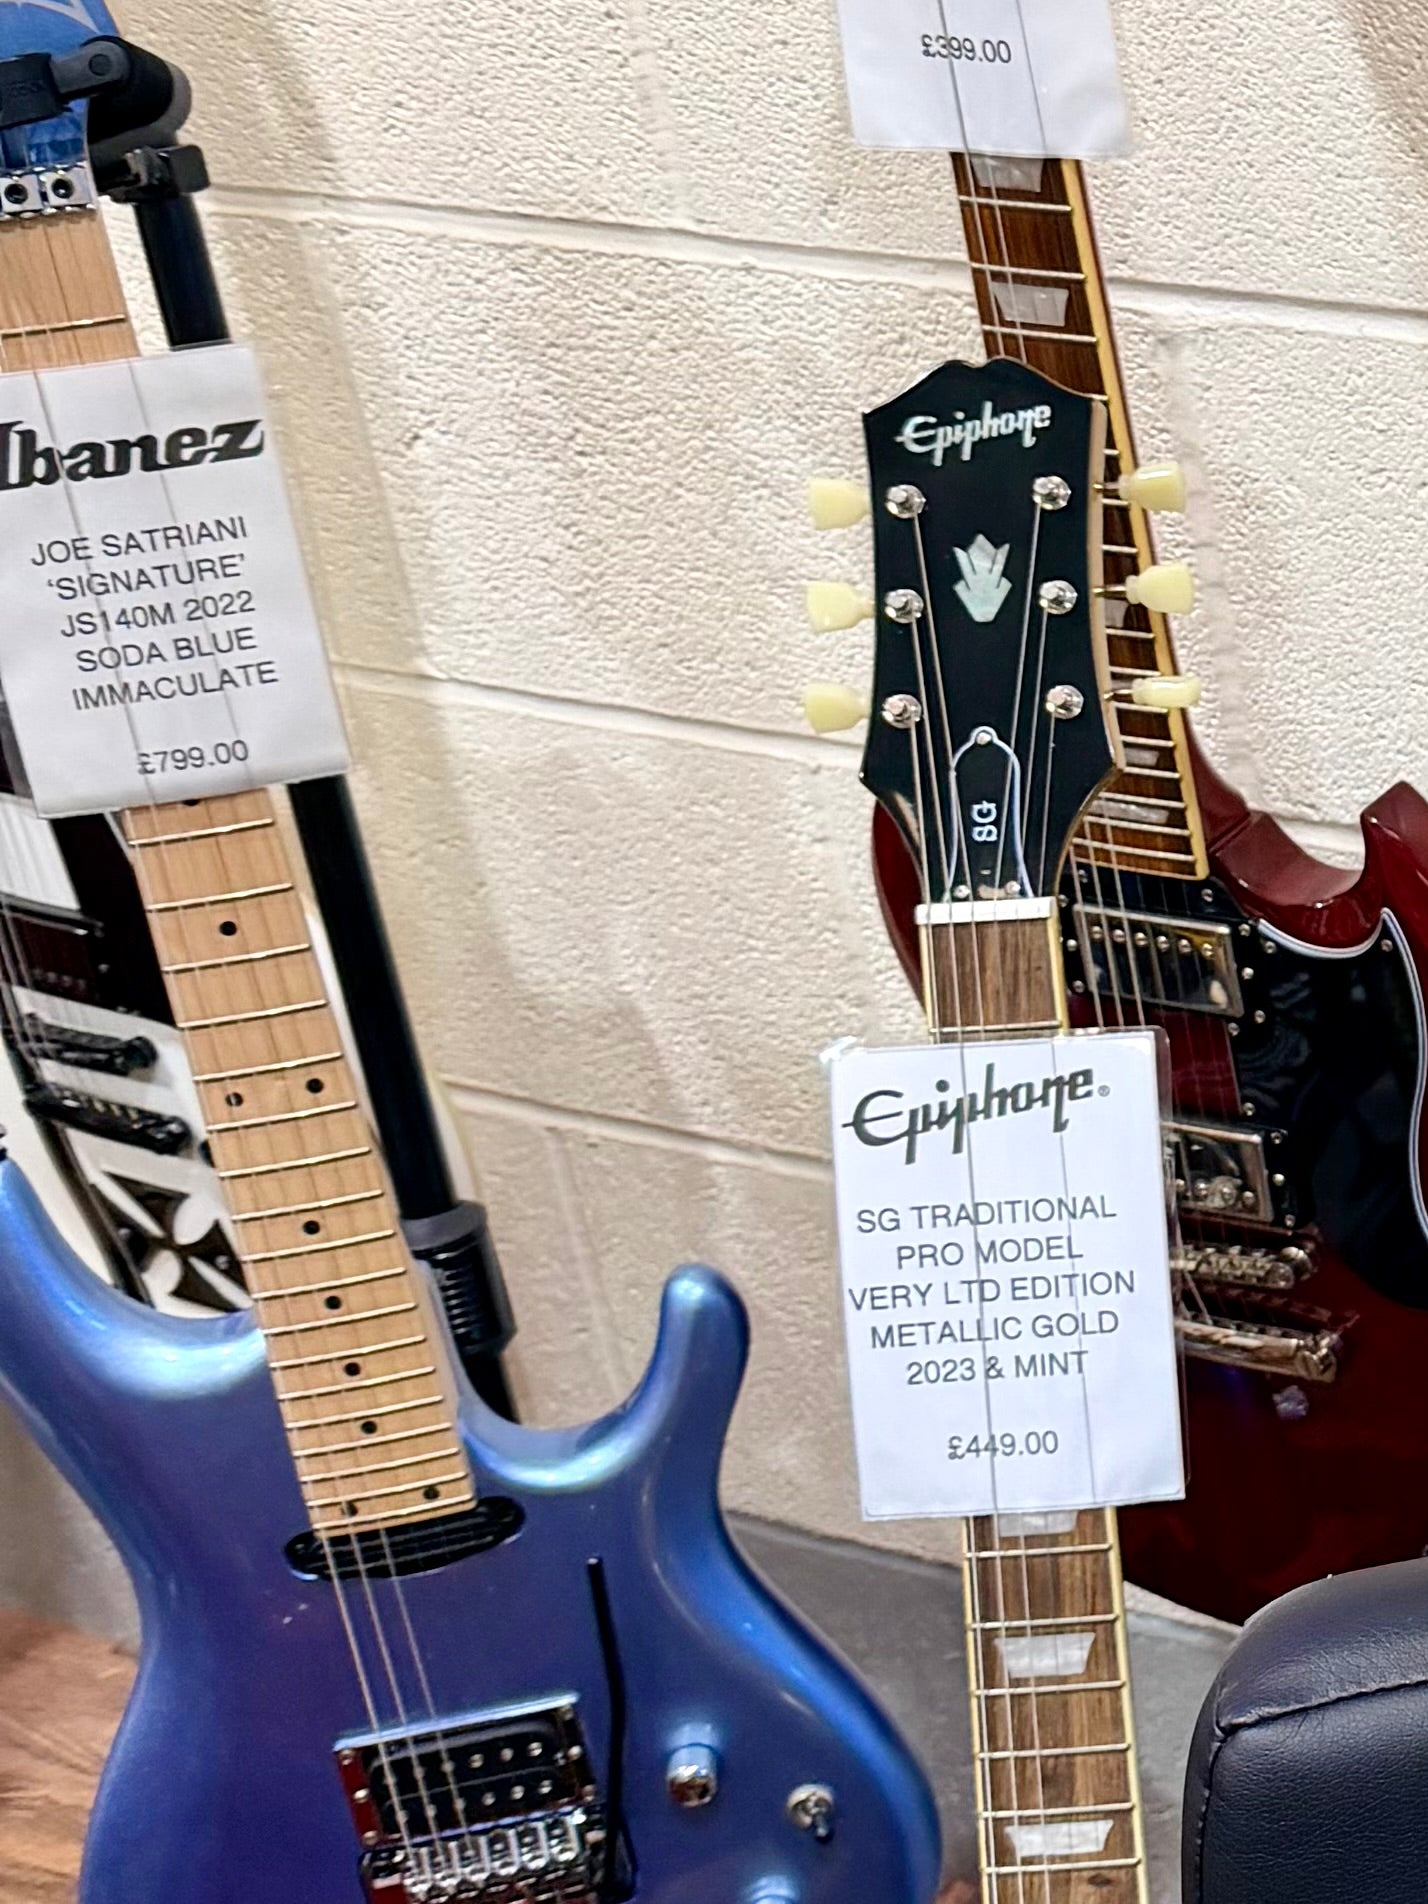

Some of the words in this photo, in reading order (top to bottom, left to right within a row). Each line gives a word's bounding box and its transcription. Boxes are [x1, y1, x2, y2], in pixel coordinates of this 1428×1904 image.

[921, 34, 1012, 64] £399.00
[896, 400, 1052, 466] Epiphone
[30, 536, 94, 567] JOE
[101, 516, 248, 557] SATRIANI
[60, 602, 177, 638] JS140M
[184, 590, 256, 622] 2022
[76, 641, 168, 673] SODA
[172, 627, 258, 661] BLUE
[72, 661, 279, 711] IMMACULATE
[137, 739, 250, 775] £799.00
[970, 800, 998, 843] SG
[842, 1062, 1095, 1165] Epiphone
[856, 1208, 901, 1234] SG
[910, 1194, 1118, 1230] TRADITIONAL
[896, 1241, 964, 1270] PRO
[976, 1235, 1084, 1265] MODEL
[848, 1282, 933, 1312] VERY
[944, 1278, 1001, 1305] LTD
[1010, 1270, 1135, 1301] EDITION
[871, 1315, 1023, 1349] METALLIC
[1031, 1310, 1120, 1339] GOLD
[906, 1356, 976, 1386] 2023
[985, 1355, 1005, 1380] &
[1014, 1350, 1089, 1379] MINT
[947, 1430, 1060, 1461] £449.00
